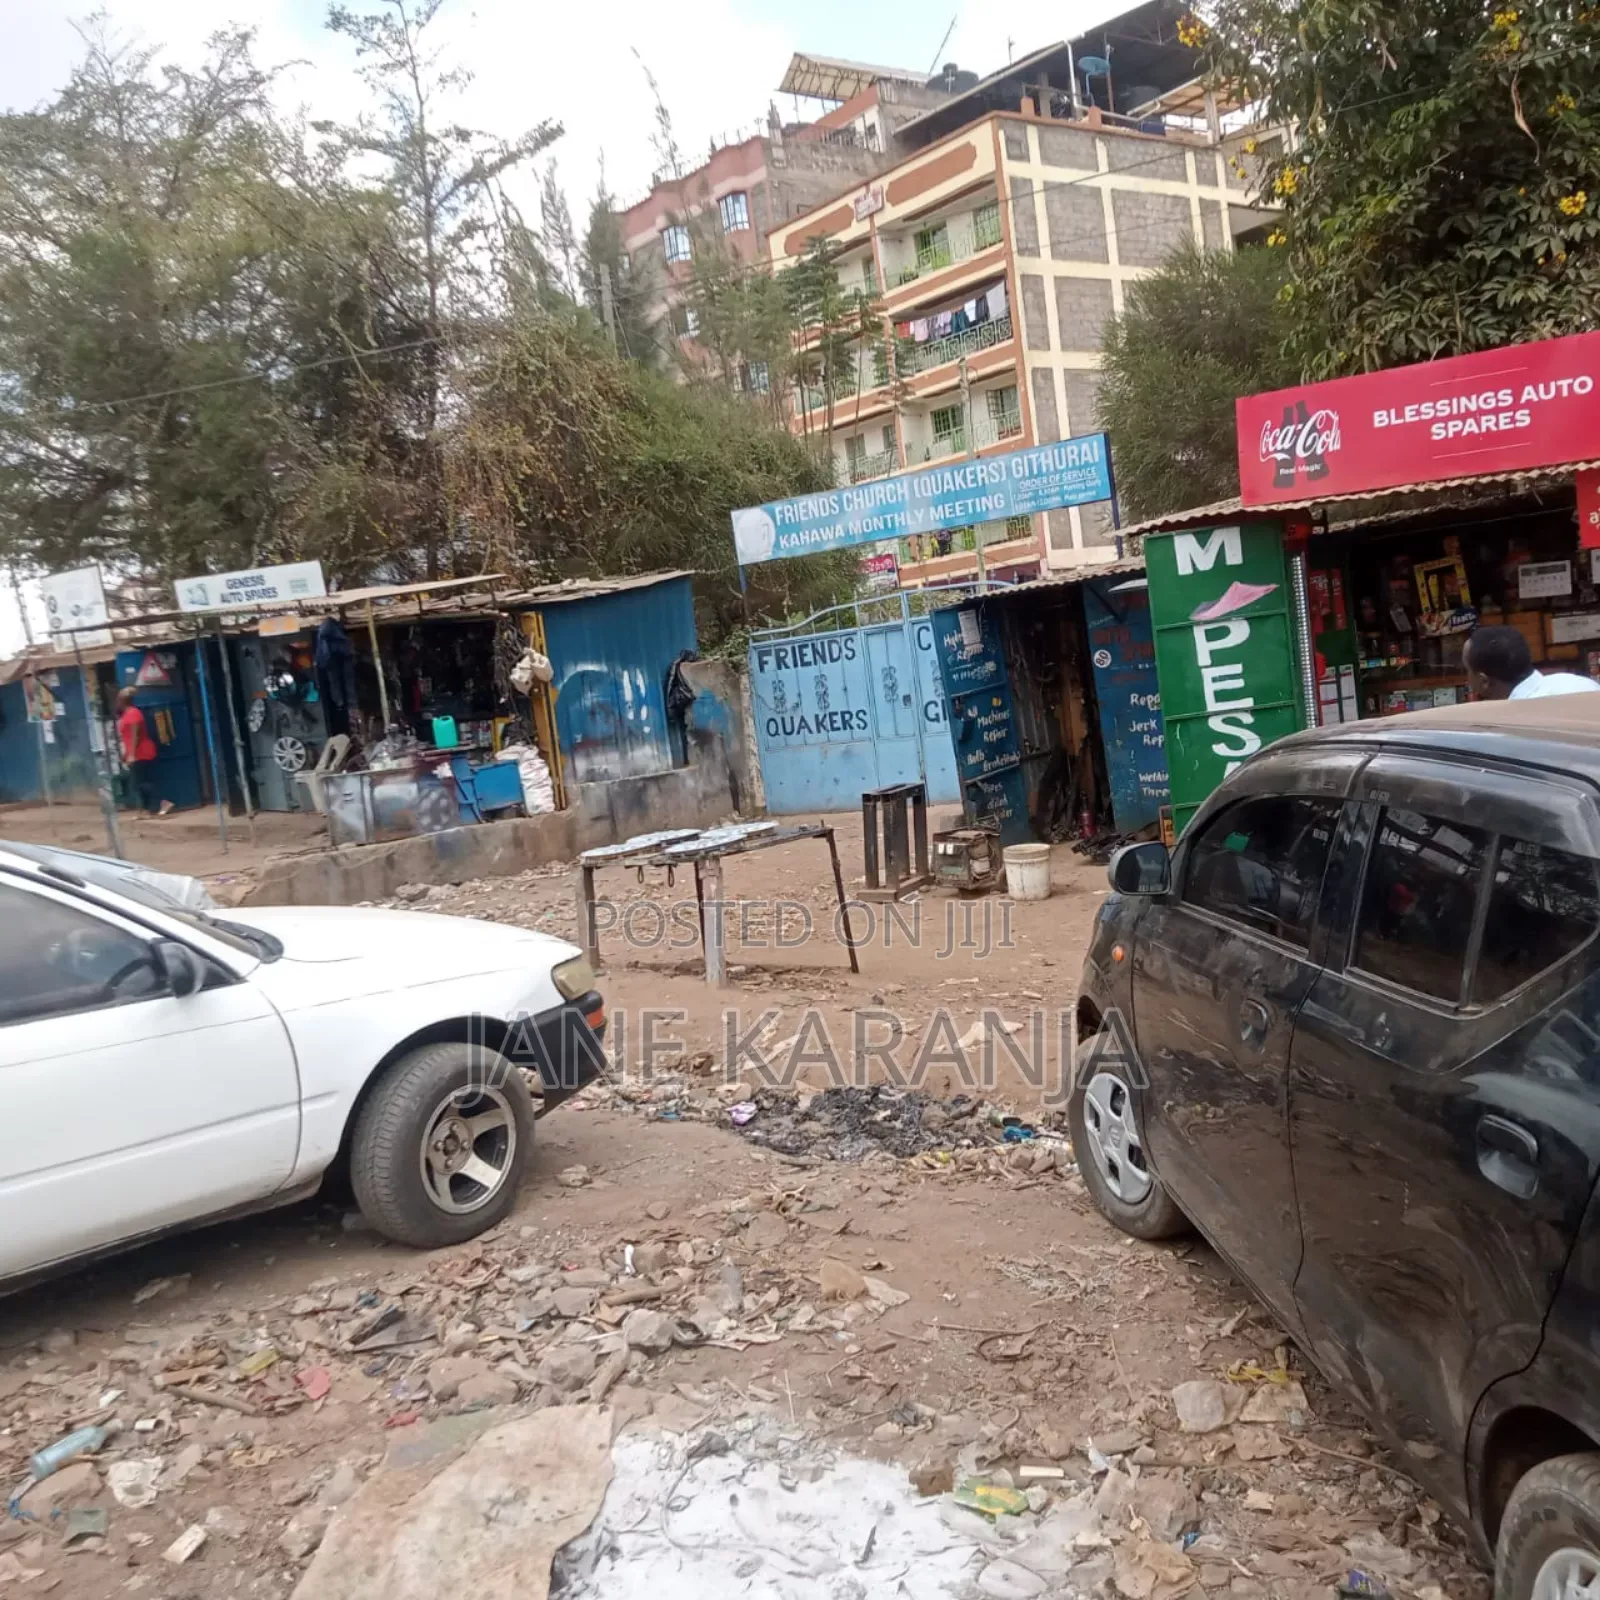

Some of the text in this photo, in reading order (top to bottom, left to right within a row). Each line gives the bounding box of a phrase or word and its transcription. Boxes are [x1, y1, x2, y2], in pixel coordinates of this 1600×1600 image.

[1373, 375, 1594, 428] BLESSINGS AUTO
[1431, 409, 1531, 440] SPARES
[774, 495, 840, 526] FRIENDS
[843, 480, 909, 512] CHURCH
[1011, 441, 1099, 479] GITHURAI
[1020, 467, 1097, 489] ORDER OF SERVICE
[779, 523, 845, 549] KAHAWA
[848, 508, 925, 535] MONTHLY
[929, 493, 1005, 520] MEETING
[1173, 526, 1243, 575] M
[220, 586, 278, 604] AUTO SPARES
[226, 574, 265, 590] GENESIS
[758, 637, 856, 673] FRIENDS
[766, 709, 868, 738] QUAKERS
